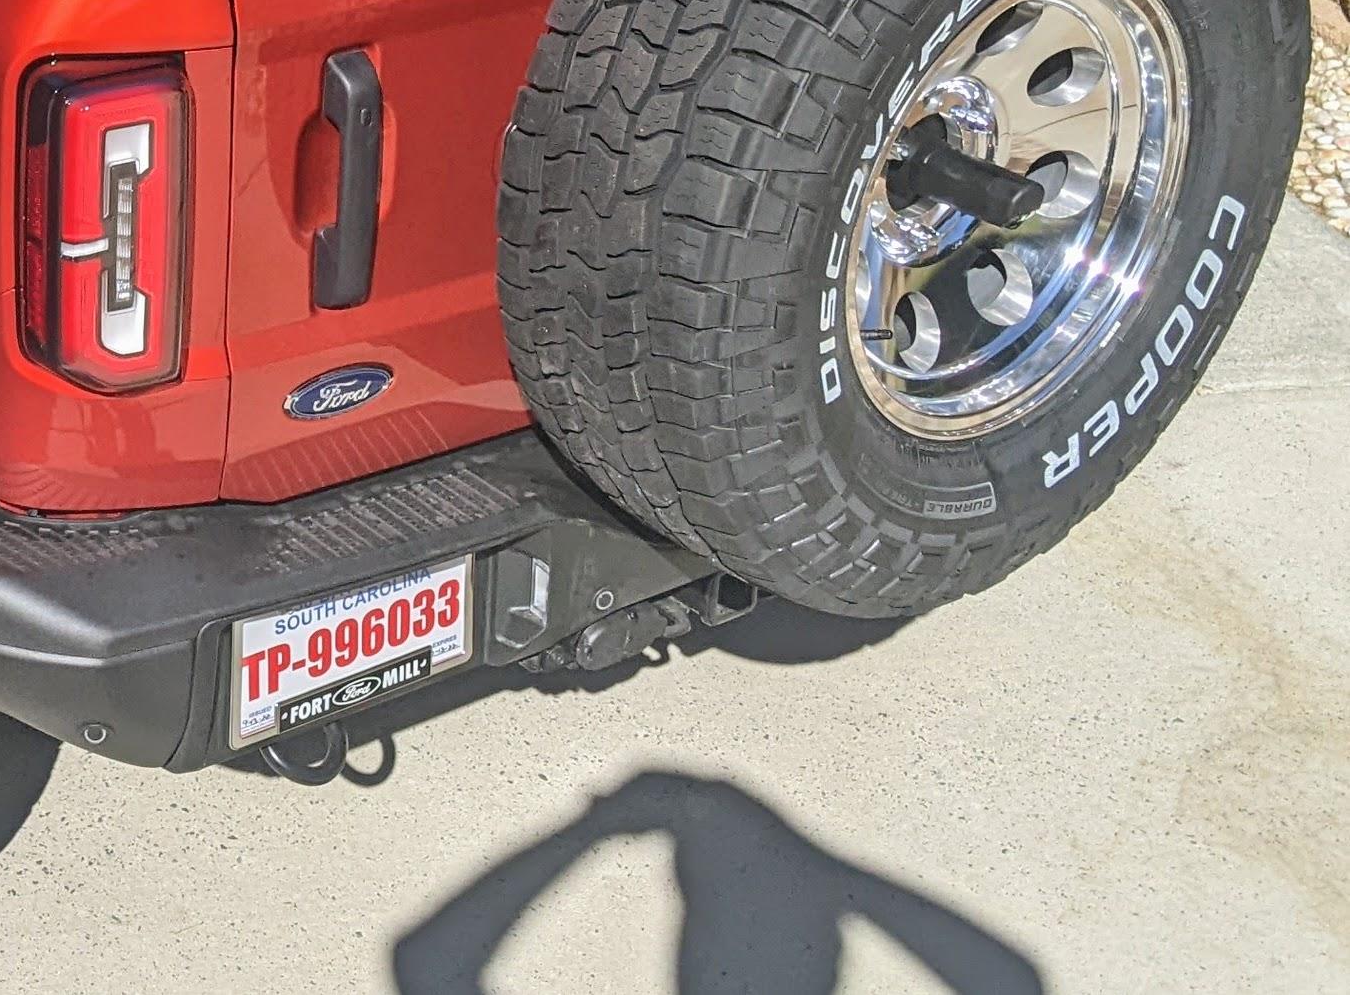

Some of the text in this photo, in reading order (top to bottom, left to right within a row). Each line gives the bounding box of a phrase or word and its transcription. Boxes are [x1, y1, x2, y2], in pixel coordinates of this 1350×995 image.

[1043, 194, 1246, 488] COOPER
[312, 379, 372, 412] Ford
[926, 498, 993, 514] DURABLE
[275, 566, 432, 635] SOUTH CAROLINA
[241, 579, 460, 702] TP-996033
[289, 693, 333, 724] FORT
[341, 680, 373, 703] Ford
